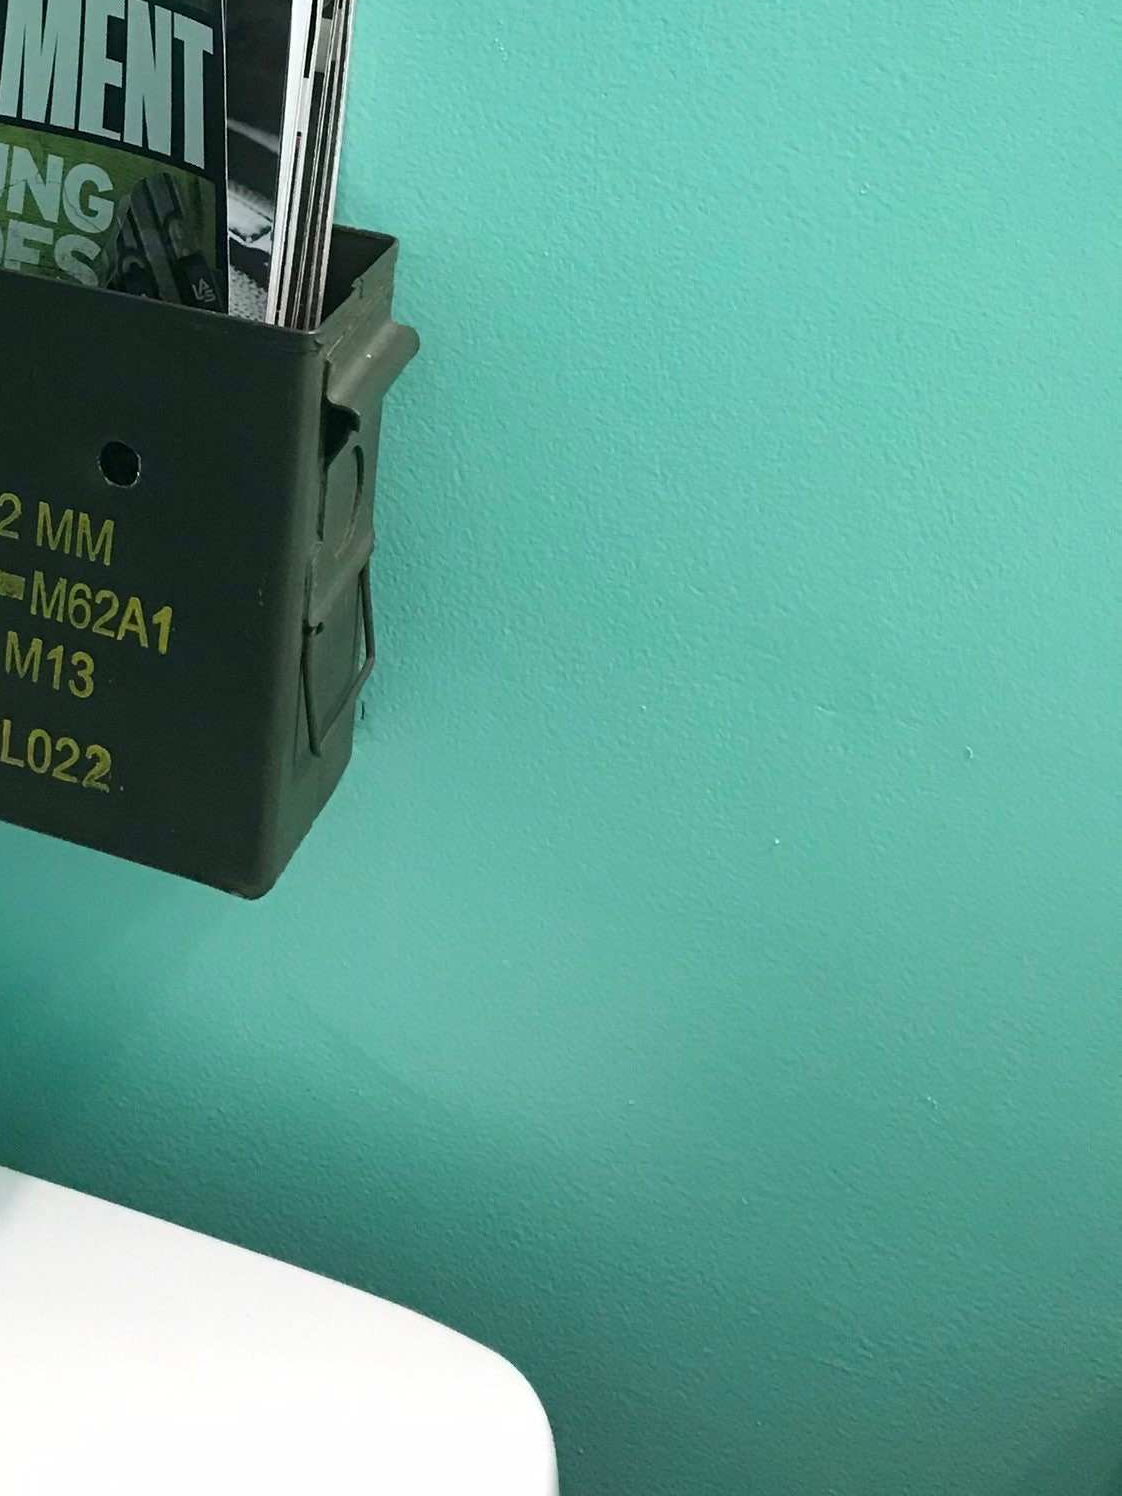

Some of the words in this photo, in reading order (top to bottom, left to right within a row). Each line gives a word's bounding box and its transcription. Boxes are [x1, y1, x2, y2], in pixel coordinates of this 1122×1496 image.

[36, 501, 116, 567] MM
[30, 570, 174, 655] M62A1
[4, 630, 96, 699] M13
